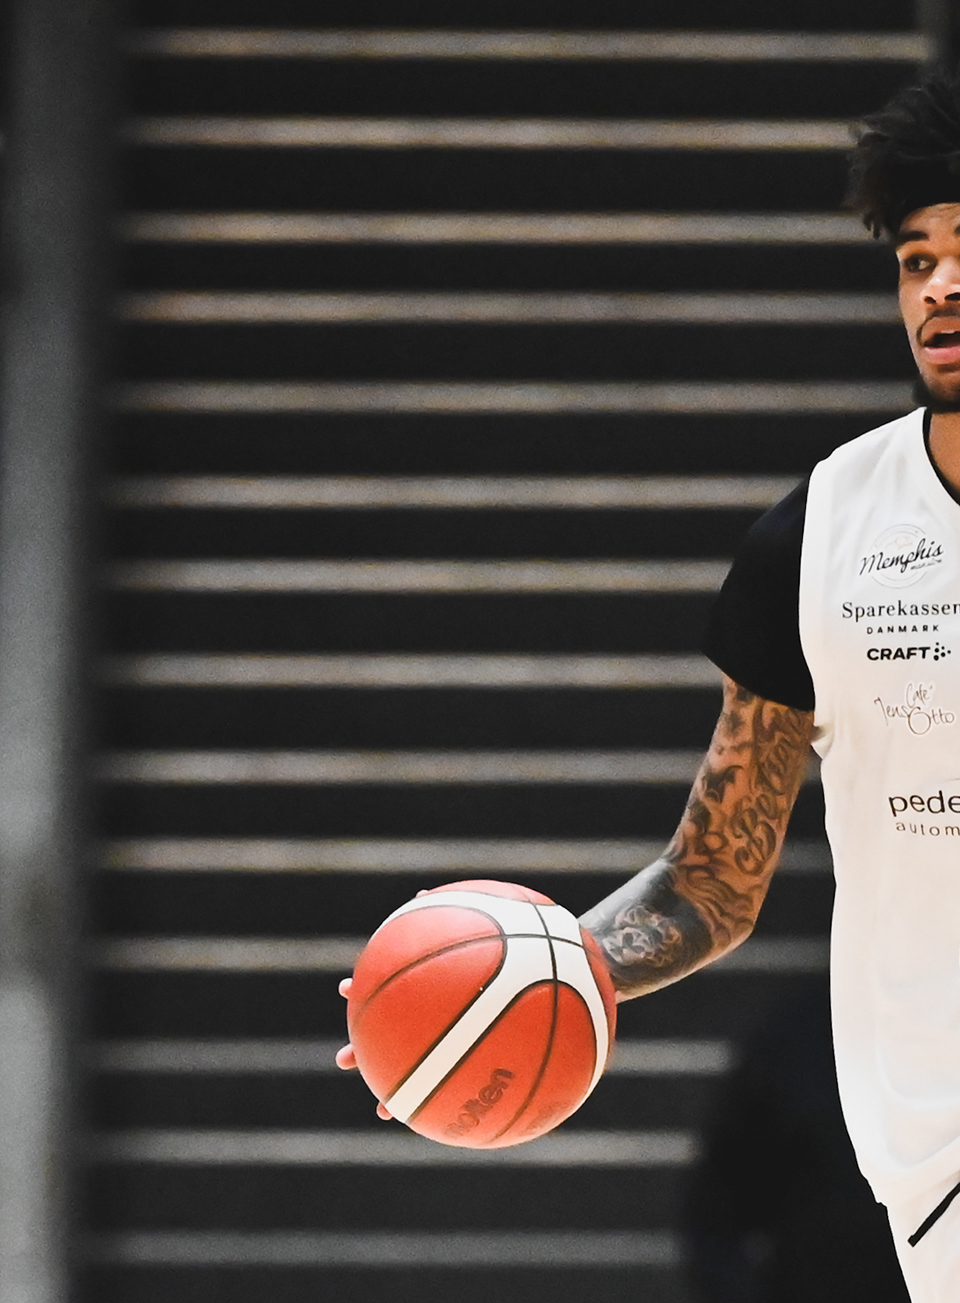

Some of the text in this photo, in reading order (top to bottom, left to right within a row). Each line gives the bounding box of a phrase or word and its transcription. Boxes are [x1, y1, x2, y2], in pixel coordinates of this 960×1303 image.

[859, 537, 944, 575] Memphis
[866, 624, 940, 635] DANMARK
[866, 646, 931, 661] CRAFT
[908, 706, 954, 735] Otto
